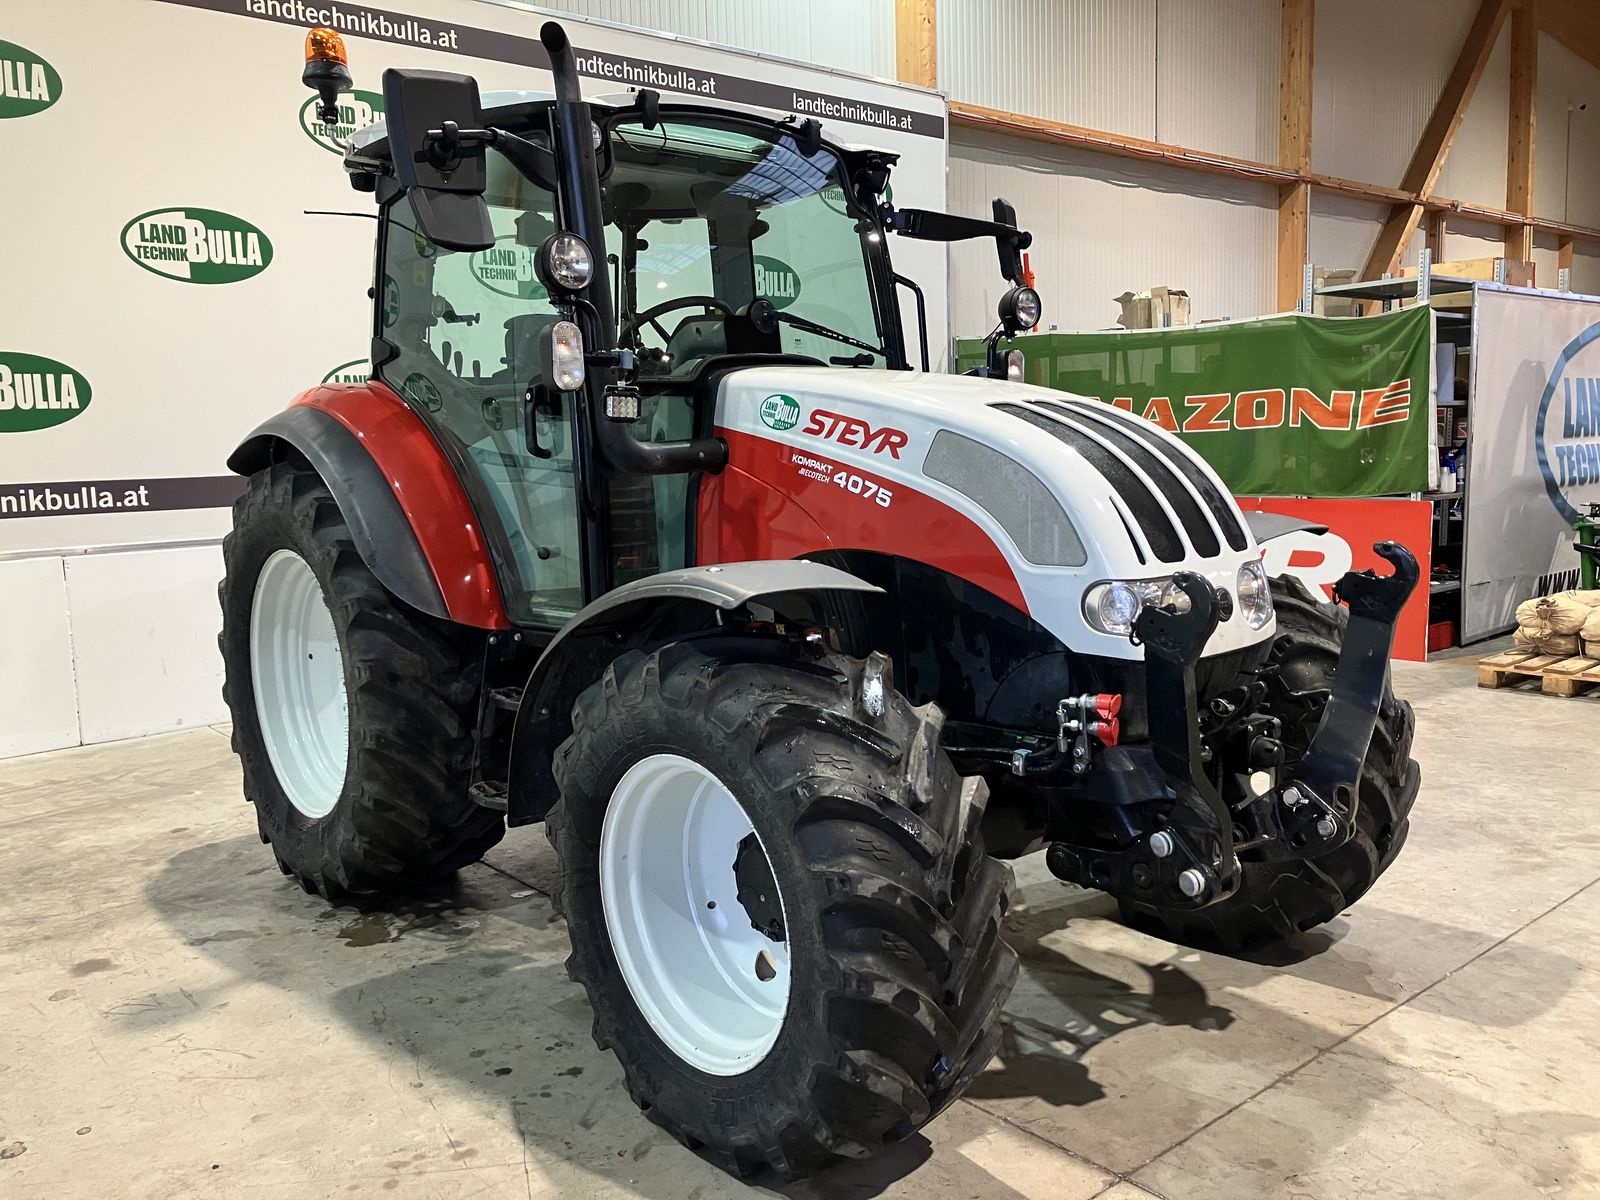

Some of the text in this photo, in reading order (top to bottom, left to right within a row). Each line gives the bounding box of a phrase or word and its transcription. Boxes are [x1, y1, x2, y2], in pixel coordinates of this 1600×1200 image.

[793, 92, 912, 129] landtechnikbulla.at
[139, 222, 187, 245] LAND
[186, 217, 263, 267] BULLA
[134, 244, 188, 262] TECHNIK
[482, 248, 517, 267] LAND
[478, 267, 518, 281] TECHNIK
[754, 263, 795, 298] BULLA
[0, 364, 80, 410] BULLA
[775, 399, 799, 425] BULLA
[802, 408, 909, 461] STEYR
[792, 454, 834, 474] KOMPAKT
[833, 471, 893, 508] 4075
